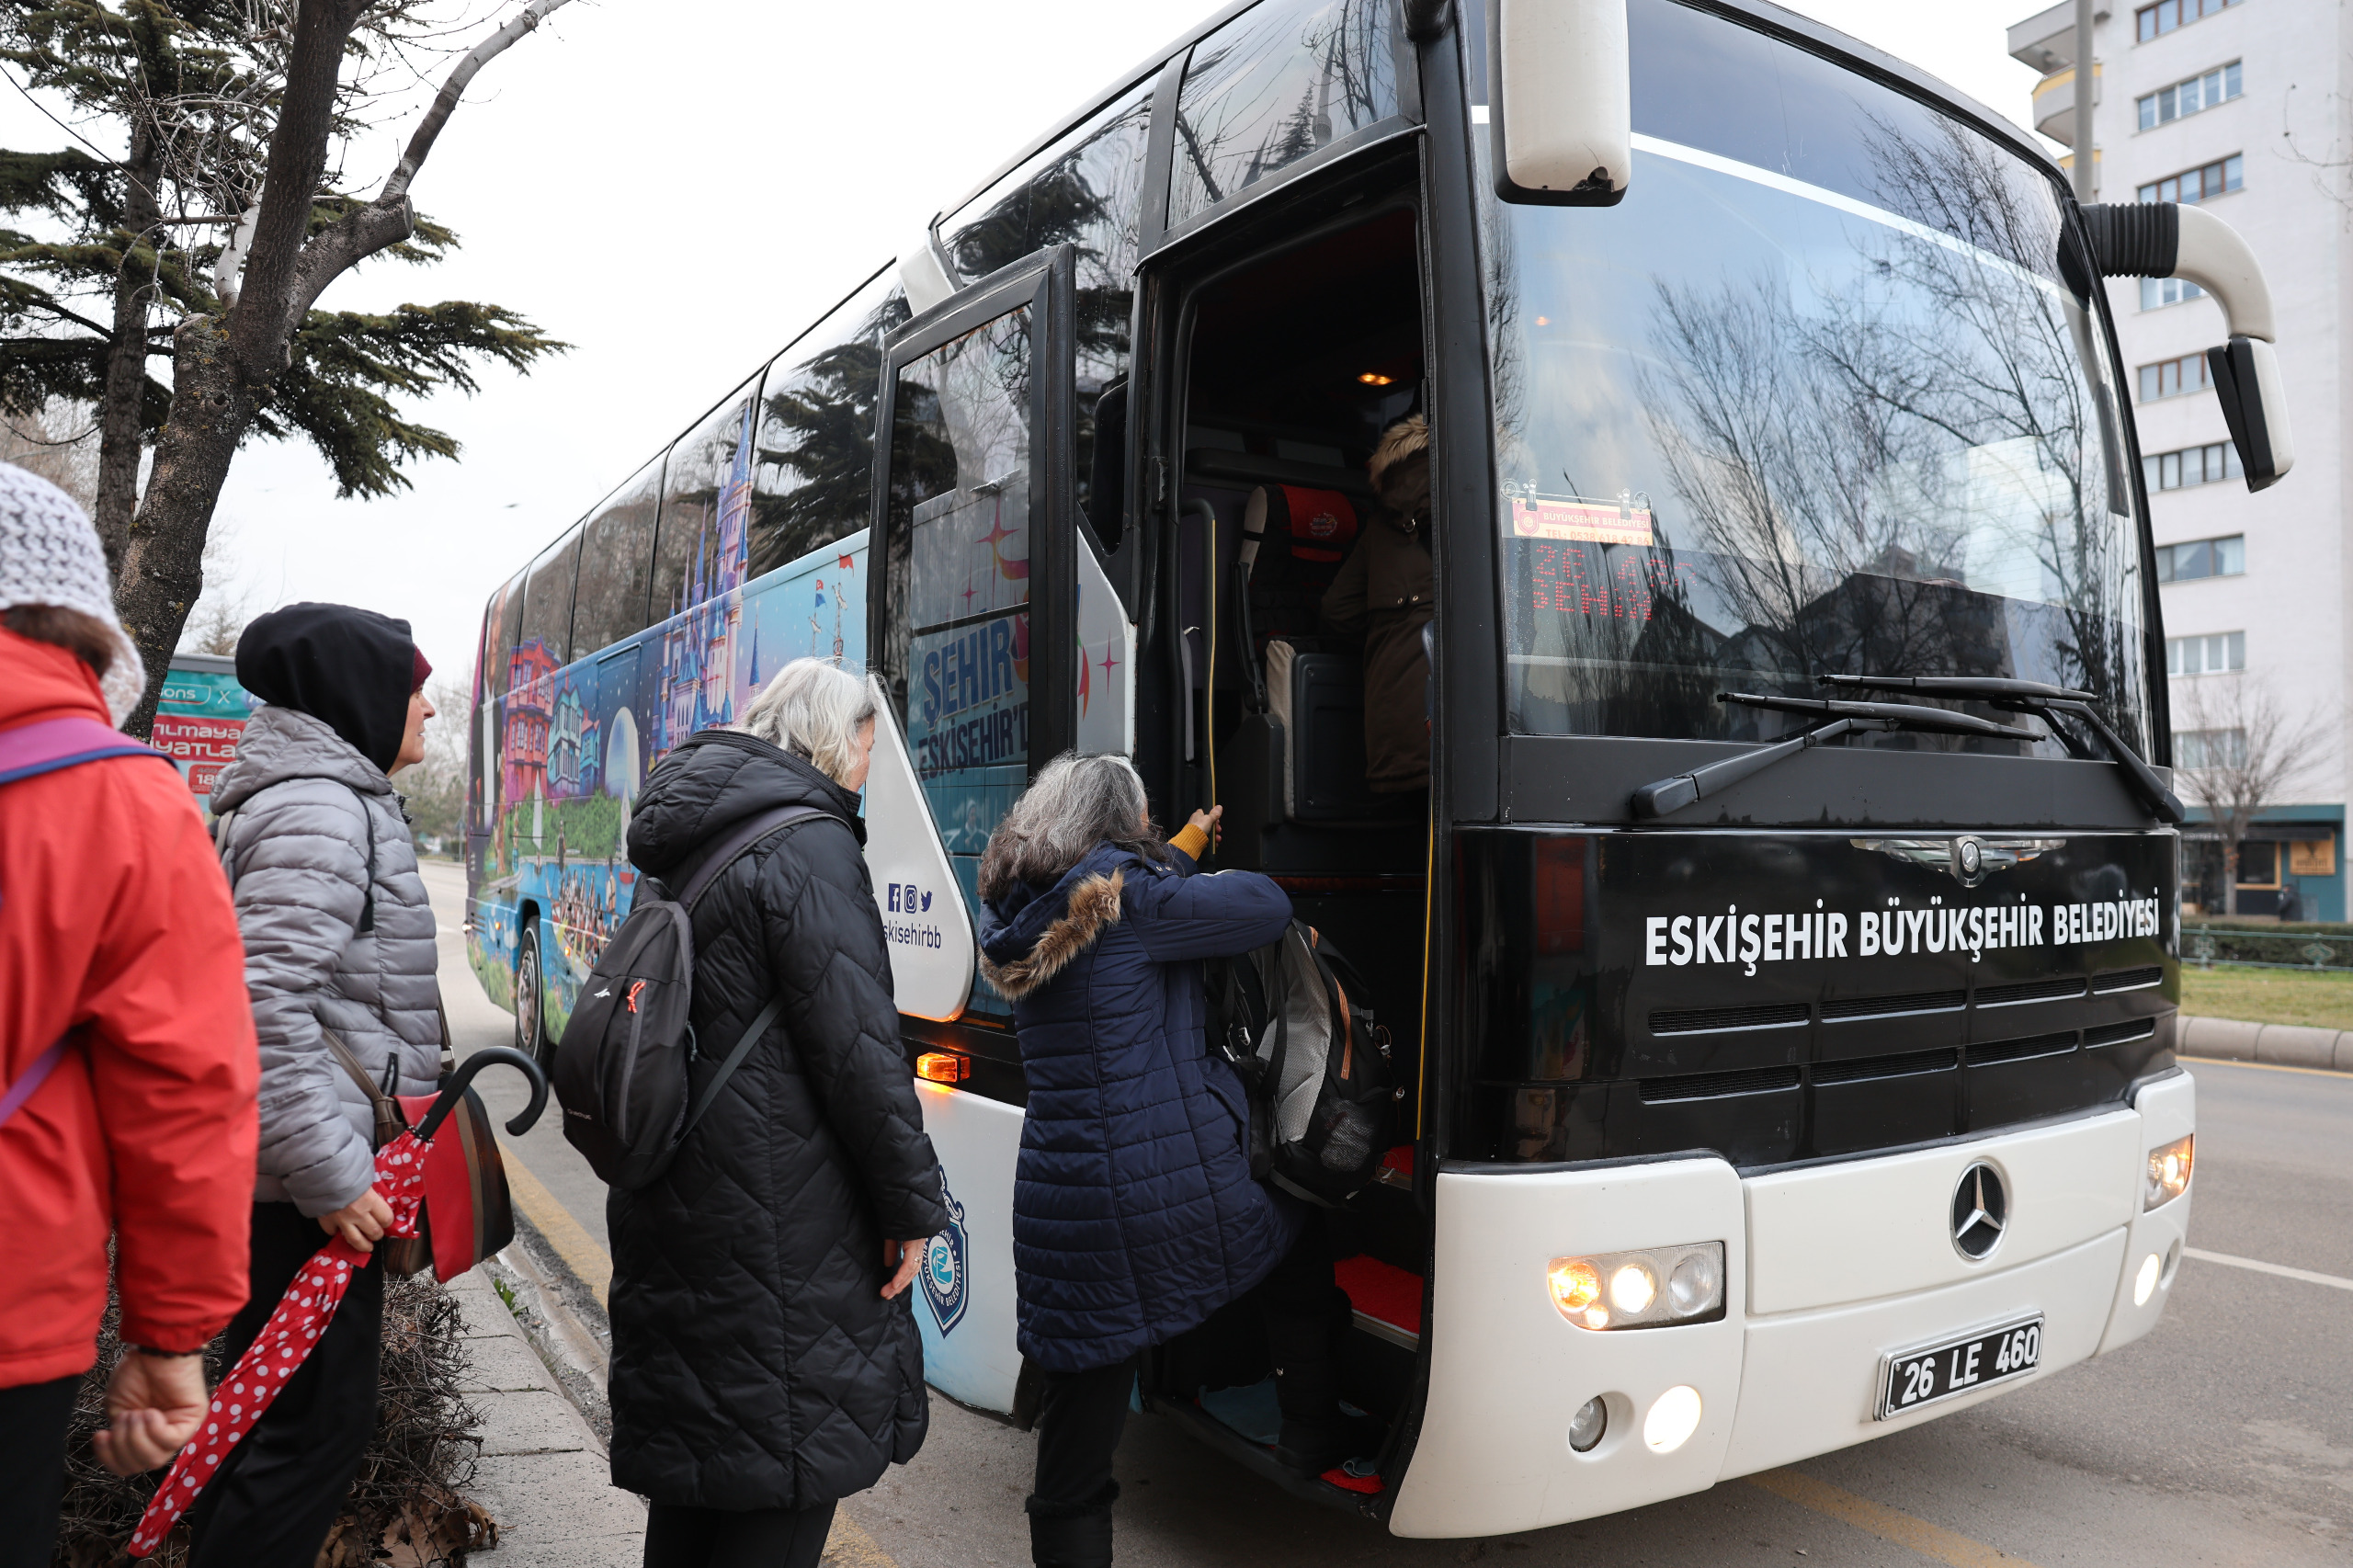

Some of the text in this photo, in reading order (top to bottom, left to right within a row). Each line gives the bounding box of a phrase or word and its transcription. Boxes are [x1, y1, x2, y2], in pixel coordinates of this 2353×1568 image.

[1543, 511, 1600, 526] BÜYÜKŞEHİR
[1545, 528, 1567, 540] TEL:
[1570, 530, 1597, 541] 0538
[1620, 535, 1633, 544] 42
[1637, 537, 1650, 546] 86
[924, 608, 1014, 732] ŞEHİR
[161, 688, 196, 699] ons
[196, 774, 218, 785] 18
[883, 920, 942, 949] skisehirbb
[1645, 887, 2160, 977] ESKİŞEHİR BÜYÜKŞEHİR BELEDİYESİ
[1901, 1325, 2040, 1405] 26 LE 460
